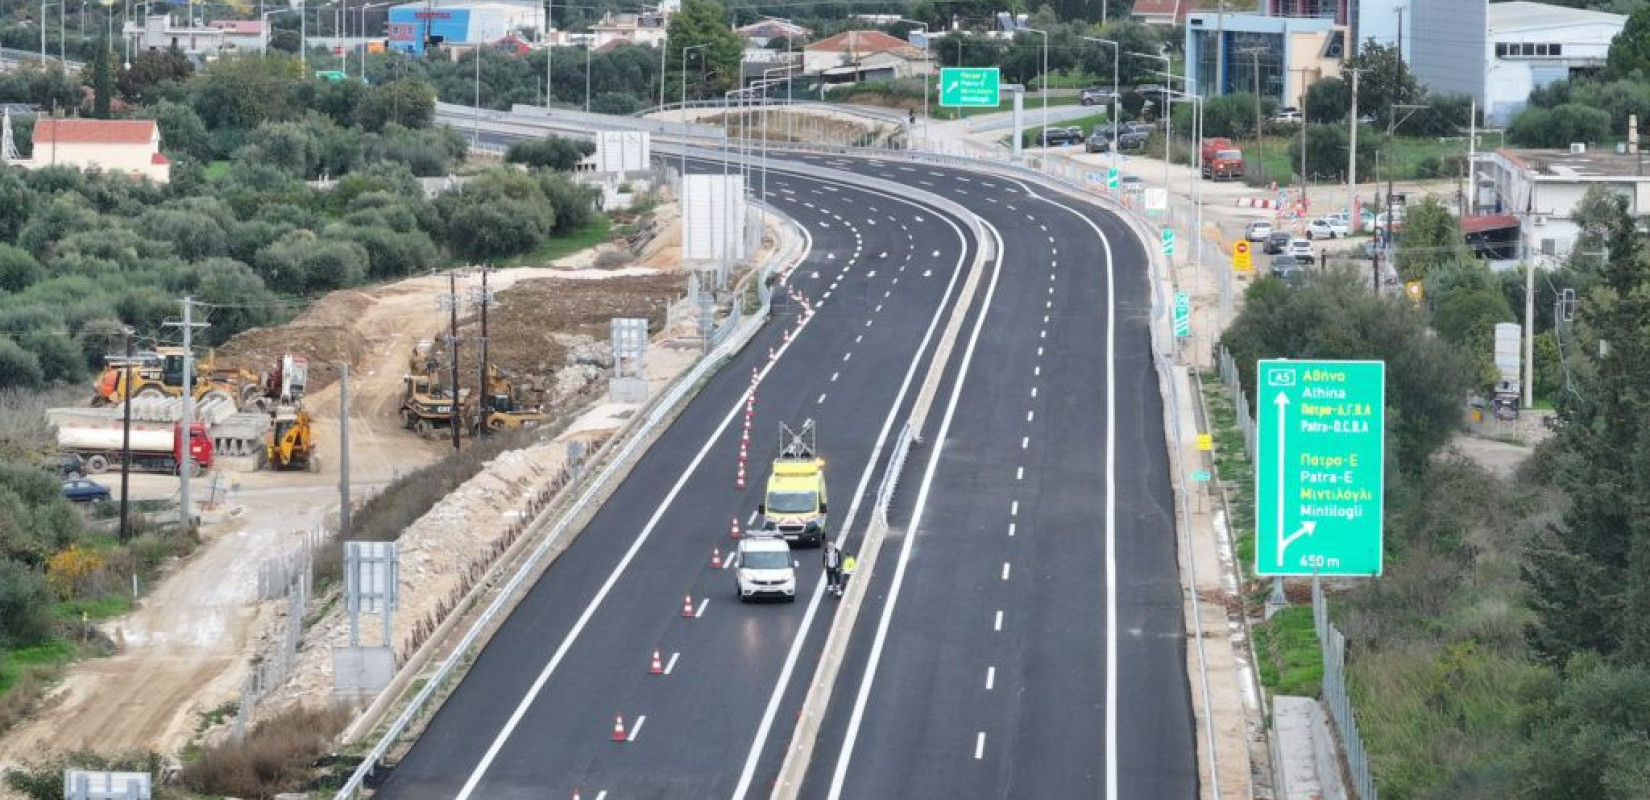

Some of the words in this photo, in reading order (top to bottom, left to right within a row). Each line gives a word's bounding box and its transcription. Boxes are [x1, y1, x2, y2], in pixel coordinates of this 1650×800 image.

[1303, 386, 1345, 398] Athina
[1301, 504, 1363, 519] Mintilogli
[1299, 554, 1325, 567] 450
[1327, 557, 1341, 568] m
